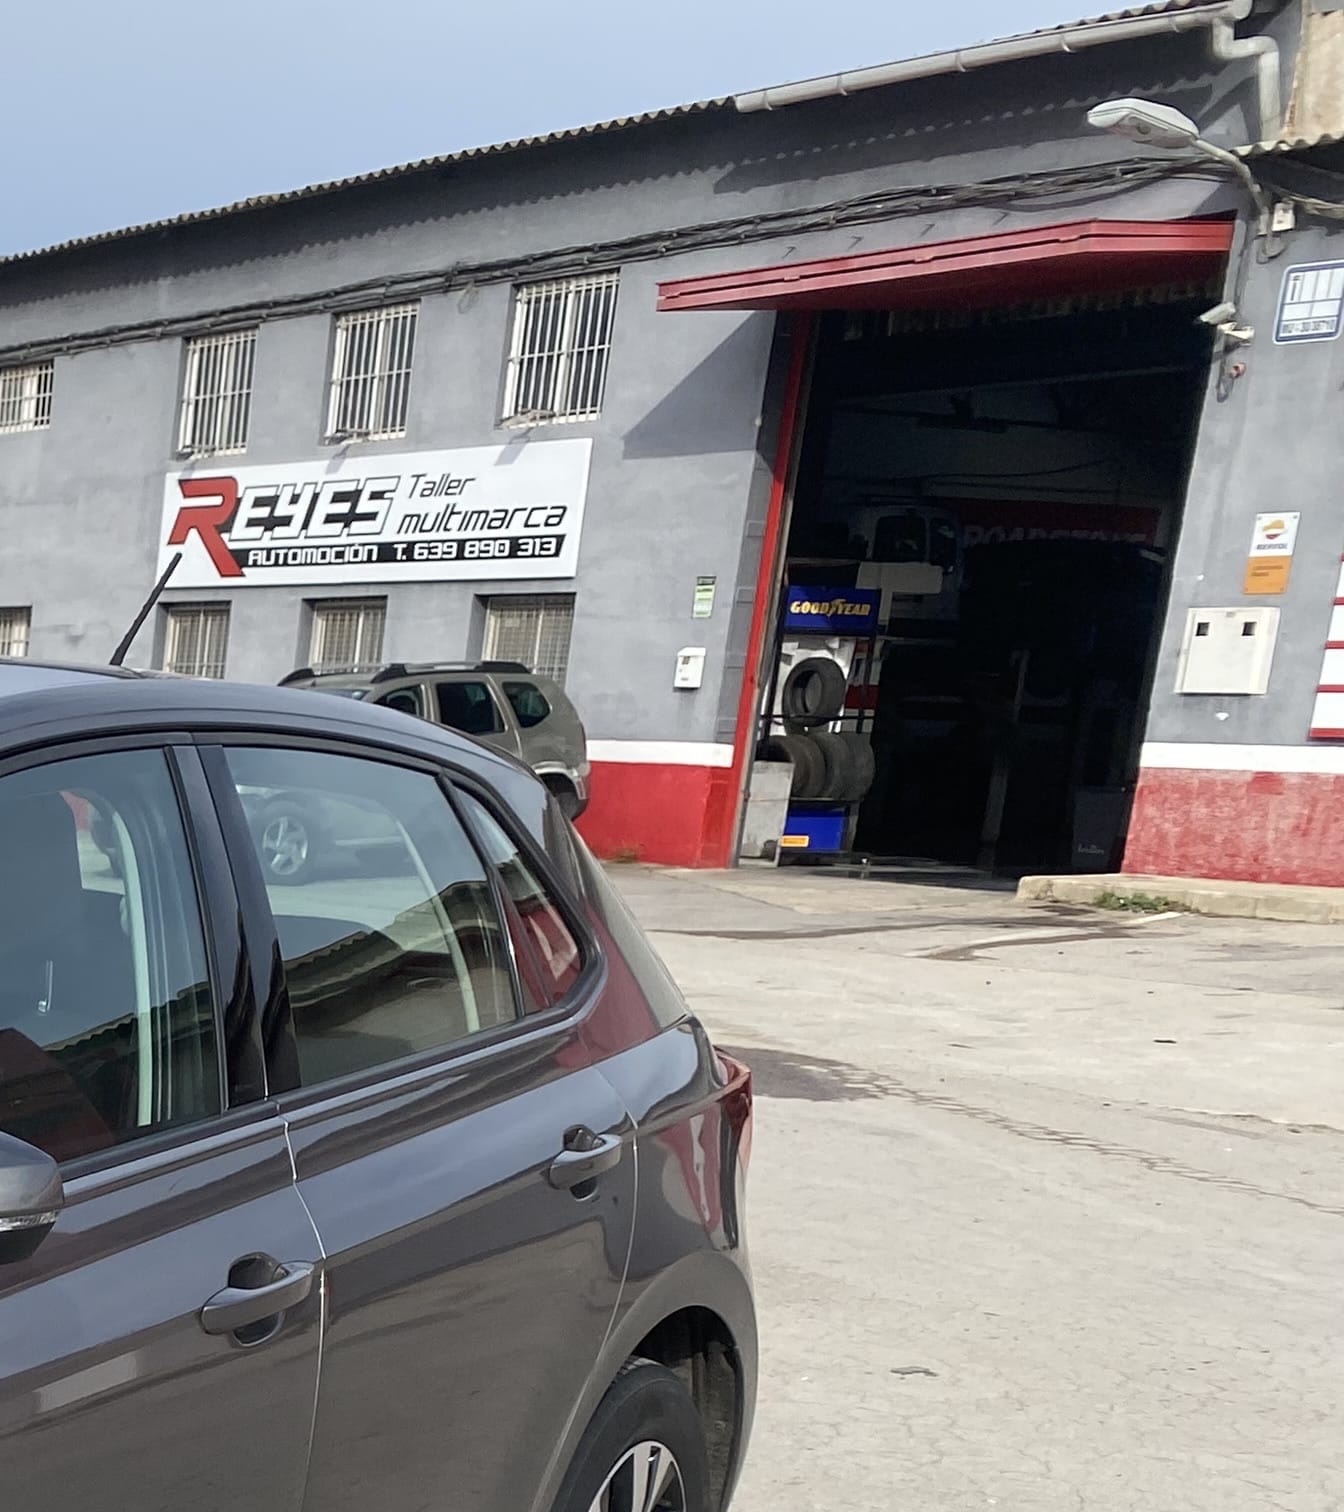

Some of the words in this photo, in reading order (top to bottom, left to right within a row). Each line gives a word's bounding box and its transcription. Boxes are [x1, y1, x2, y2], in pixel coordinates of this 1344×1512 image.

[408, 473, 476, 499] Taller
[167, 475, 402, 577] REYES
[396, 502, 568, 535] multimarca
[247, 543, 378, 566] AUTOMOCIÓN
[393, 544, 408, 561] T.
[413, 541, 458, 560] 639
[463, 539, 511, 558] 890
[516, 537, 558, 556] 313
[789, 599, 872, 616] GOODYEAR
